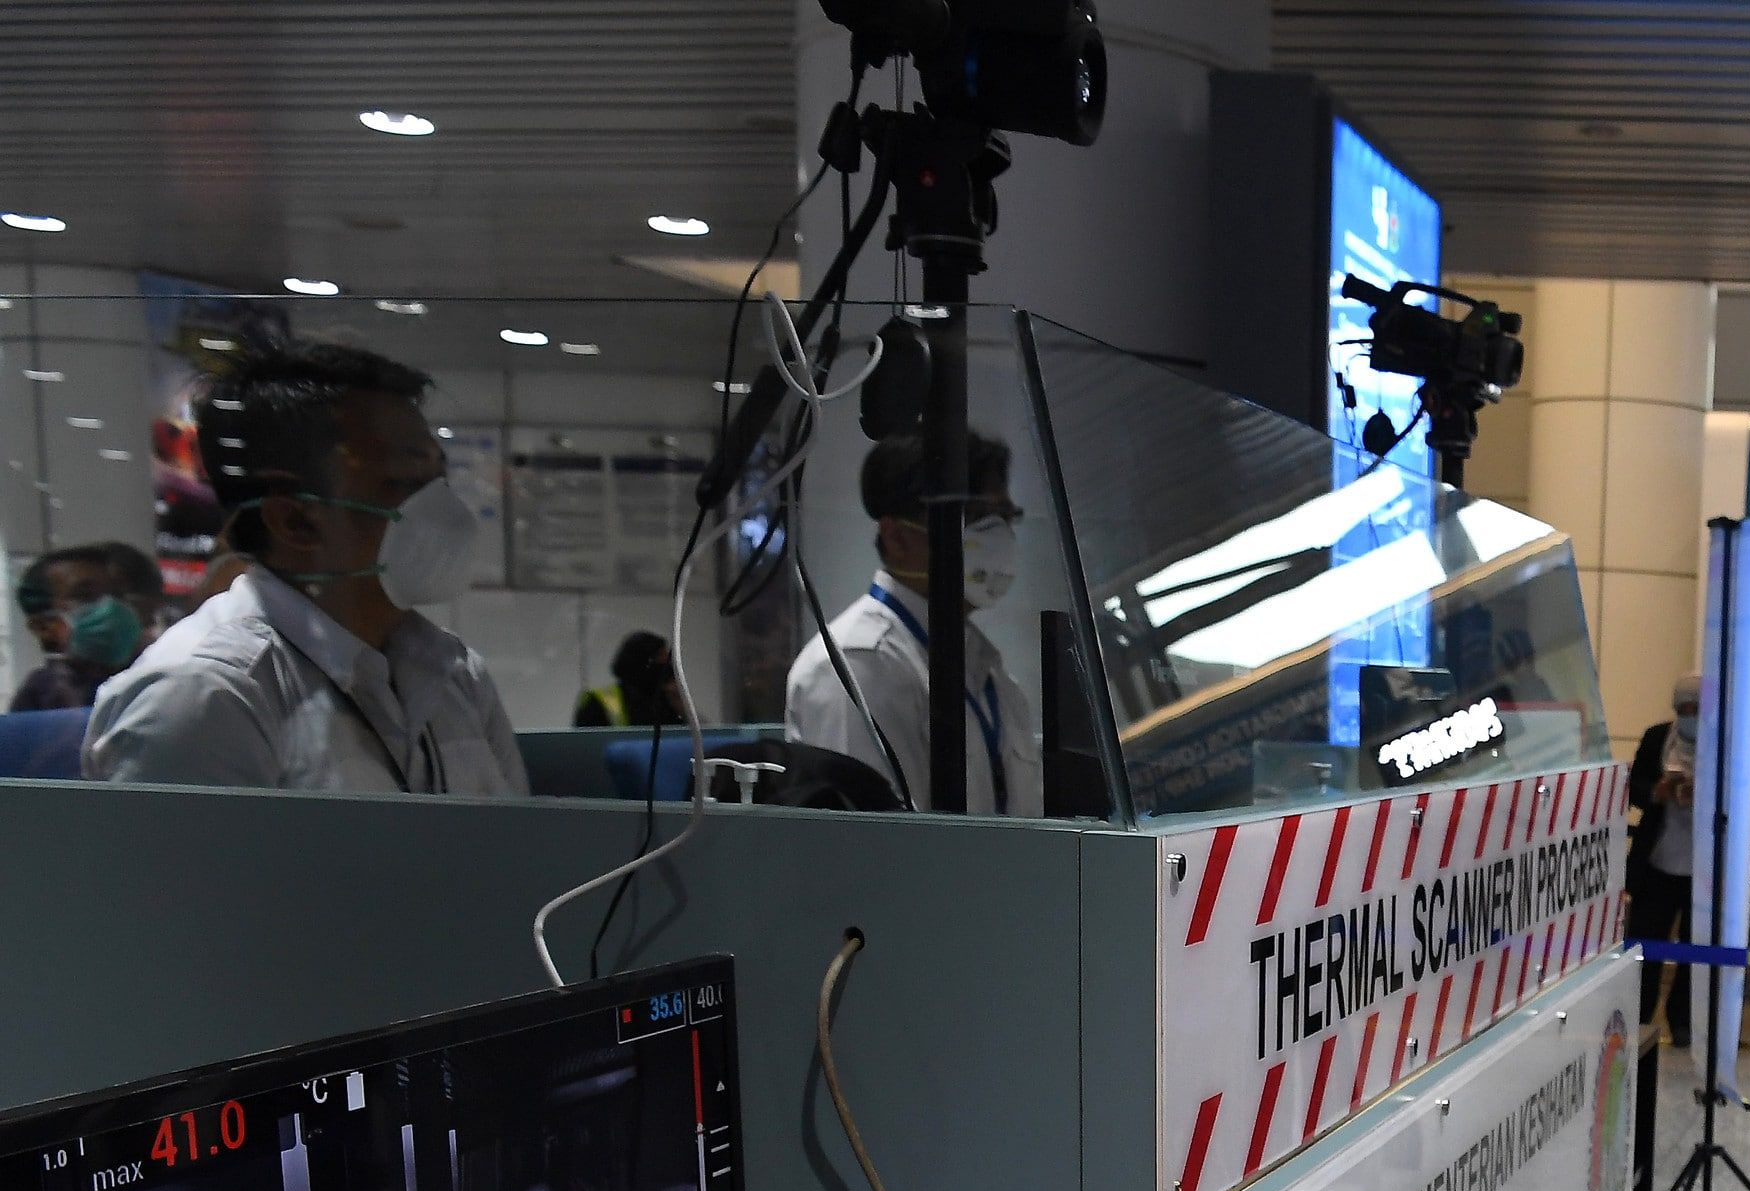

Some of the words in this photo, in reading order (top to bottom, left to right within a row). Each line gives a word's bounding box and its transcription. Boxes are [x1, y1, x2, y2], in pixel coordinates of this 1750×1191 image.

[1250, 895, 1405, 1061] THERMAL
[1411, 858, 1515, 982] SCANNER
[1517, 850, 1534, 931] IN
[1536, 828, 1610, 922] PROGRESS
[649, 991, 683, 1021] 35.6
[43, 1149, 68, 1171] 1.0
[92, 1160, 144, 1191] max
[151, 1099, 247, 1167] 41.0
[1517, 1054, 1586, 1169] KESIHATAN
